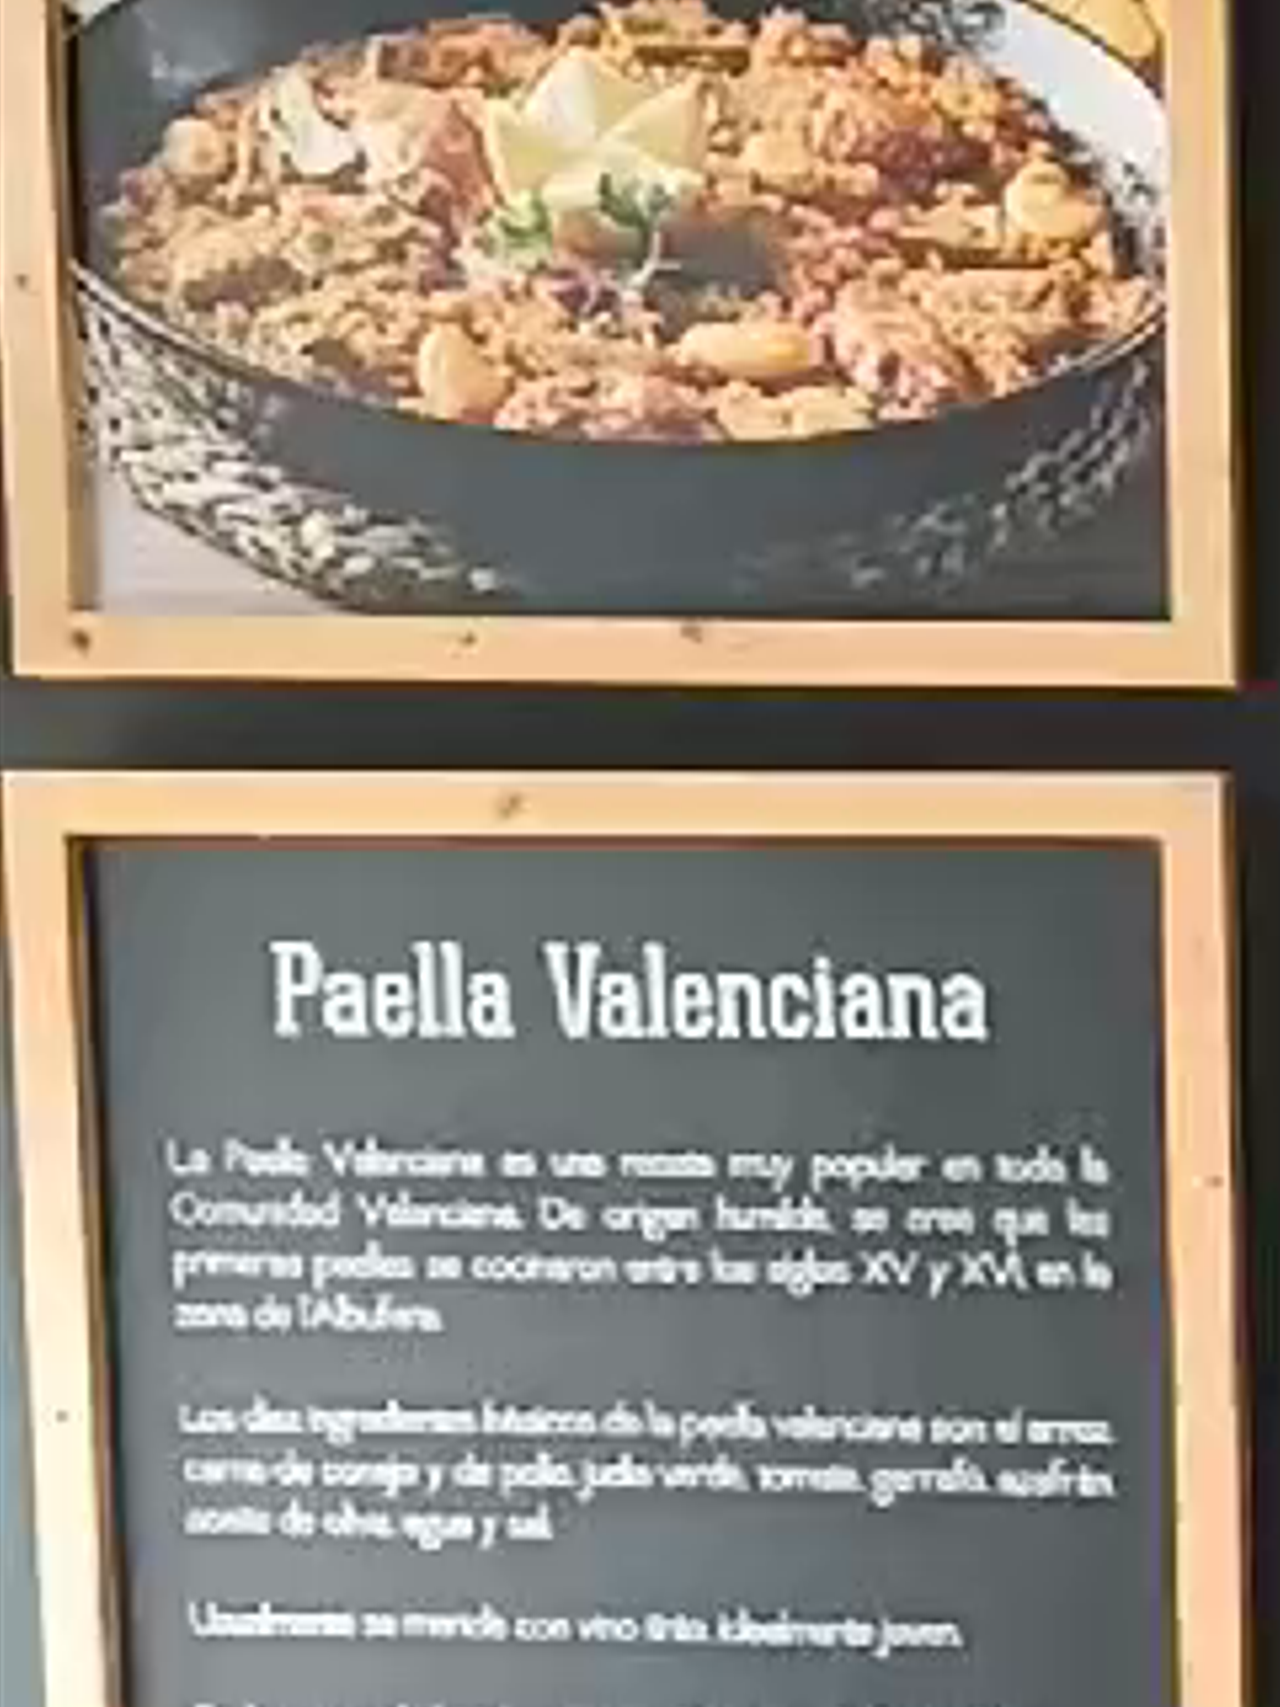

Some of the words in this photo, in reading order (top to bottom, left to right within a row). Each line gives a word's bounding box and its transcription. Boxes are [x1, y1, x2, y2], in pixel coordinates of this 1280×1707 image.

[269, 939, 514, 1038] Paella
[542, 940, 987, 1042] Valenciana
[168, 1138, 210, 1175] La
[500, 1152, 536, 1178] es
[549, 1152, 607, 1179] una
[729, 1154, 793, 1191] muy
[942, 1156, 980, 1182] en
[996, 1145, 1067, 1183] toda
[1081, 1146, 1109, 1183] la
[539, 1194, 587, 1231] De
[851, 1208, 888, 1234] se
[906, 1208, 974, 1235] cree
[994, 1209, 1049, 1247] que
[1067, 1199, 1110, 1236] las
[427, 1257, 462, 1283] se
[709, 1249, 757, 1286] los
[860, 1250, 917, 1288] XV
[1036, 1263, 1074, 1289] en
[1083, 1252, 1113, 1290] la
[173, 1307, 248, 1334] zona
[254, 1297, 291, 1334] de
[179, 1397, 236, 1434] Los
[601, 1401, 642, 1439] de
[645, 1402, 675, 1439] la
[931, 1416, 988, 1443] son
[995, 1406, 1022, 1443] el
[272, 1450, 312, 1487] de
[452, 1452, 490, 1489] de
[280, 1502, 314, 1540] de
[362, 1613, 396, 1640] se
[515, 1615, 569, 1642] con
[579, 1605, 638, 1643] vino
